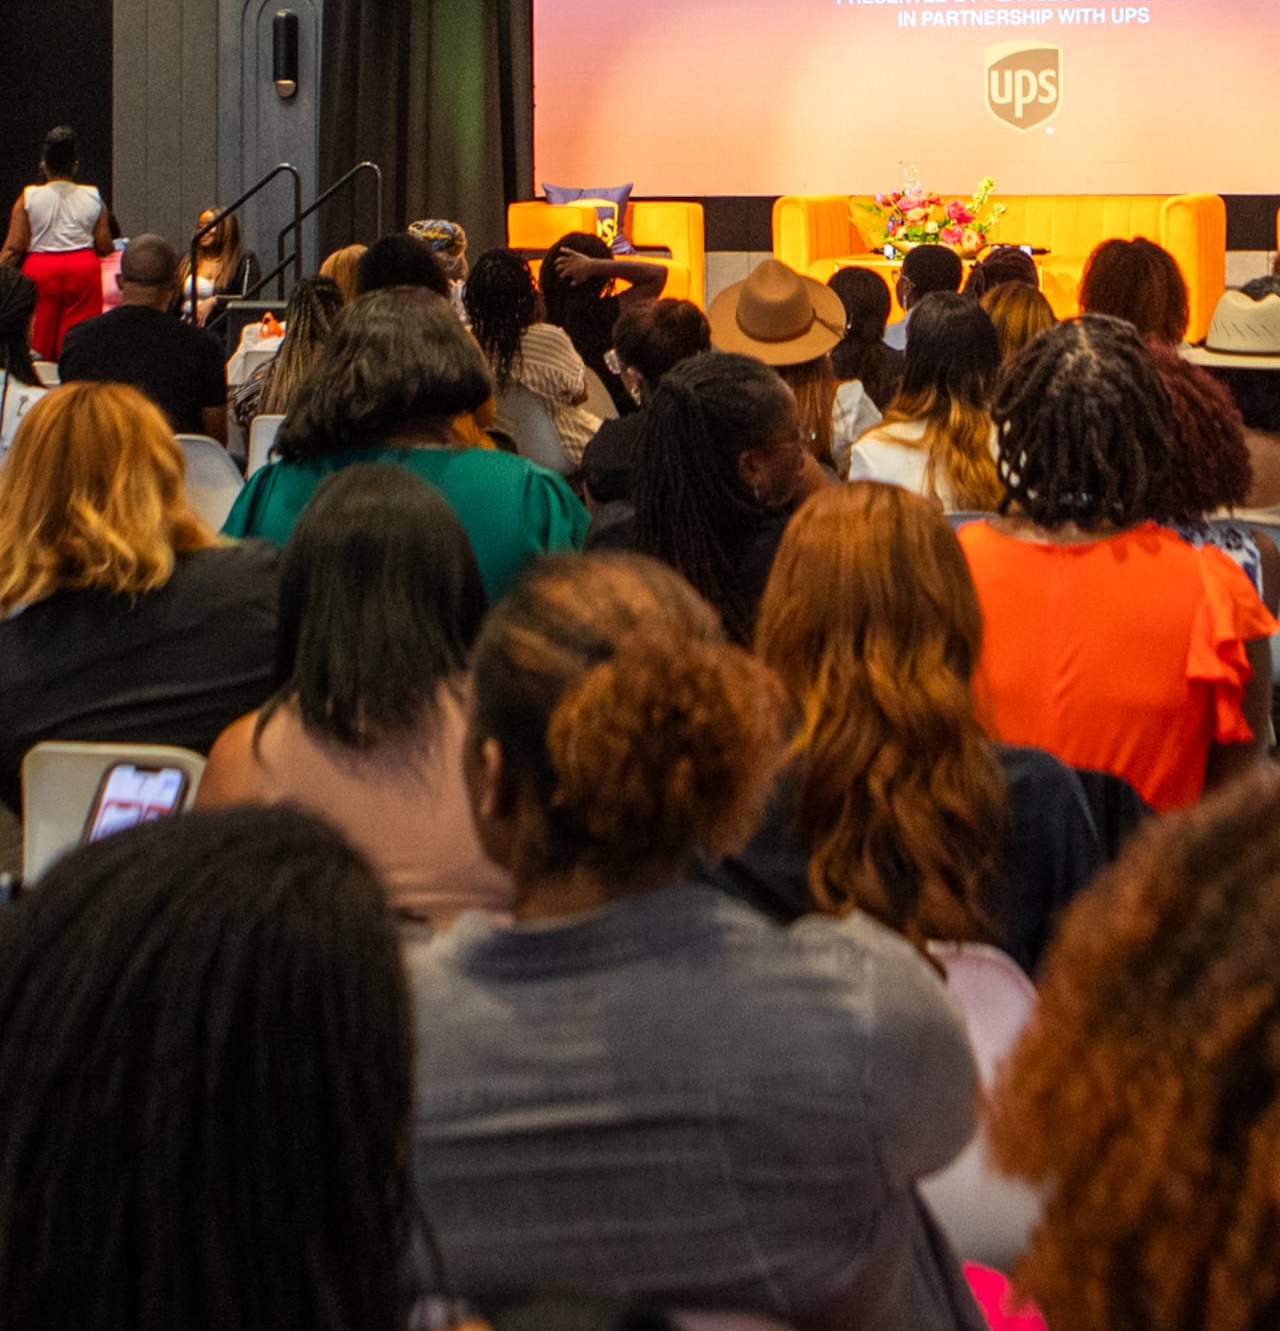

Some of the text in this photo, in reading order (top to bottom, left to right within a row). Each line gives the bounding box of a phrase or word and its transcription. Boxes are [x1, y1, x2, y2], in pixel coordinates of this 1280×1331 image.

[898, 6, 1151, 27] IN PARTNERSHIP WITH UPS
[990, 68, 1058, 118] ups
